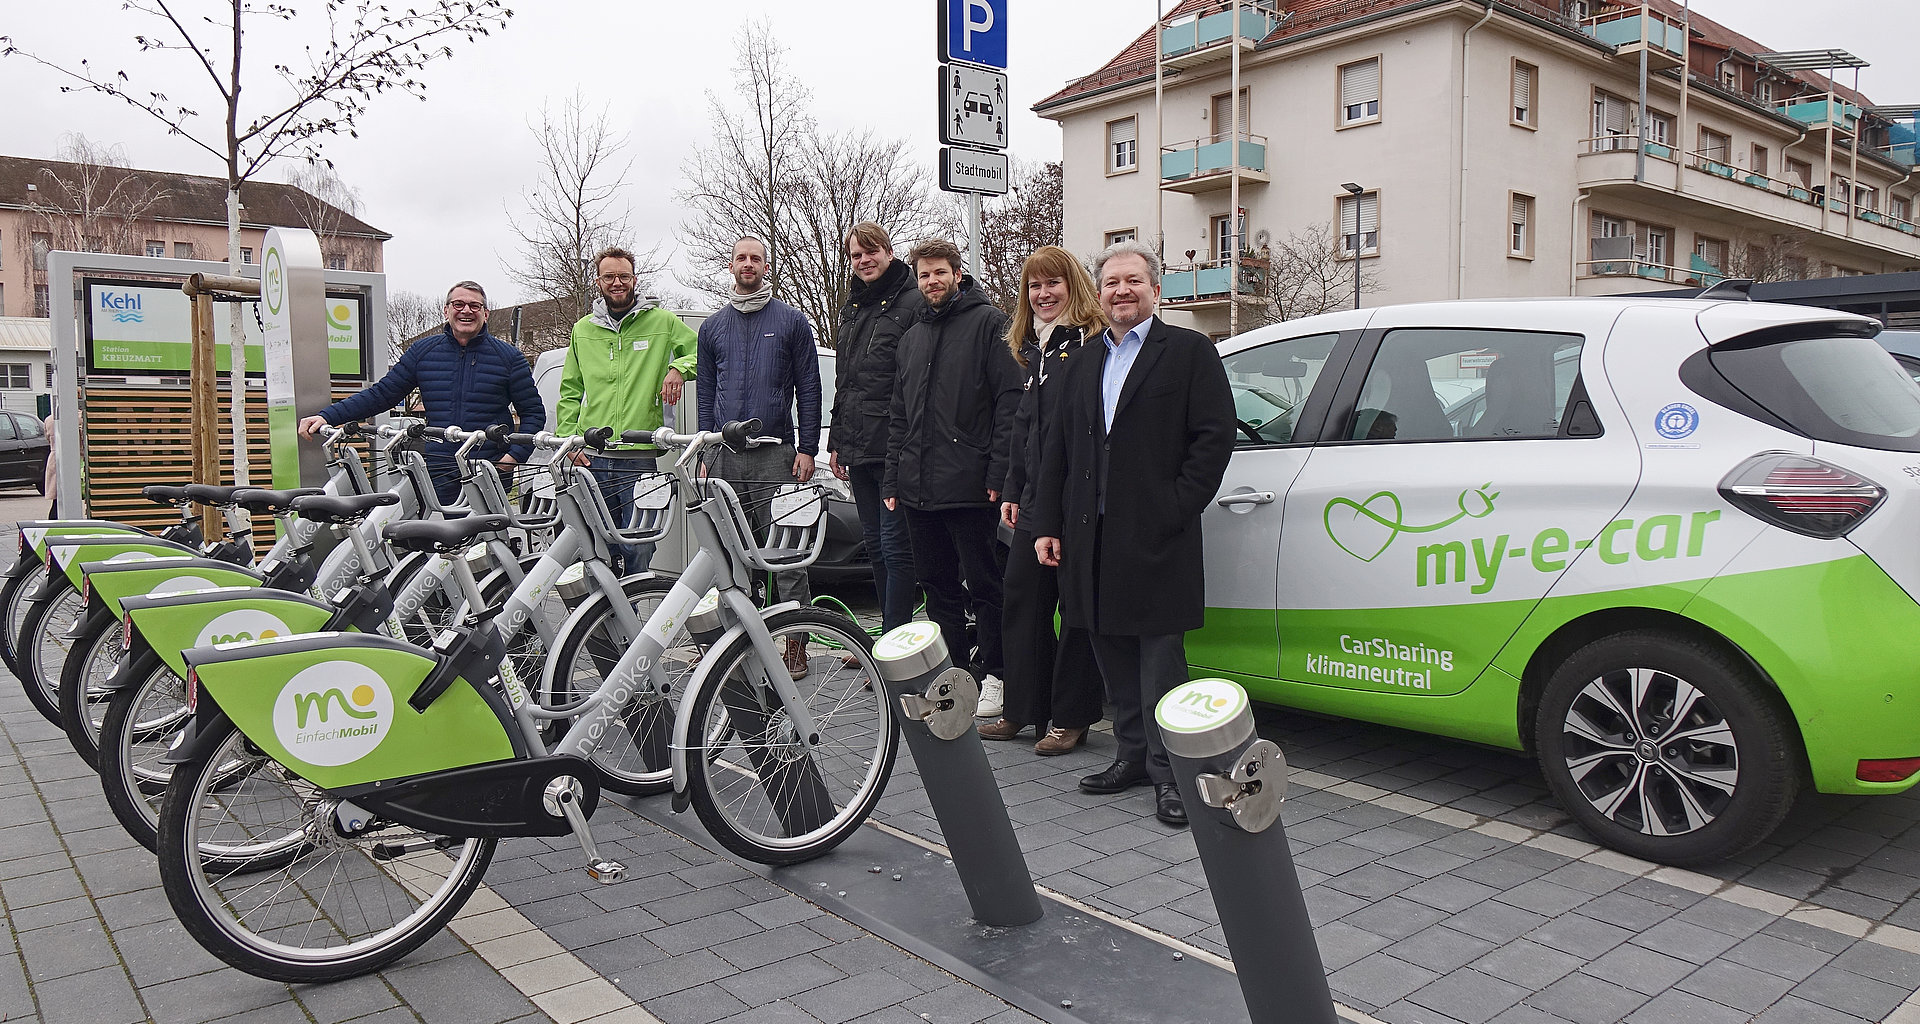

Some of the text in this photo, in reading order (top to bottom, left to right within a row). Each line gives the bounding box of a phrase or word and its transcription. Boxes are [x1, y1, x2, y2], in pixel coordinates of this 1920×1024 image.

[963, 0, 994, 52] P
[955, 161, 1002, 180] Stadtmobil
[101, 291, 141, 310] Kehl
[102, 354, 163, 363] KREUZMATT
[1416, 509, 1721, 595] my-e-car
[1306, 653, 1431, 690] klimaneutral
[1339, 634, 1454, 672] CarSharing
[499, 663, 523, 704] 355316
[575, 655, 651, 756] nextbike
[295, 723, 379, 745] EinfachMobil
